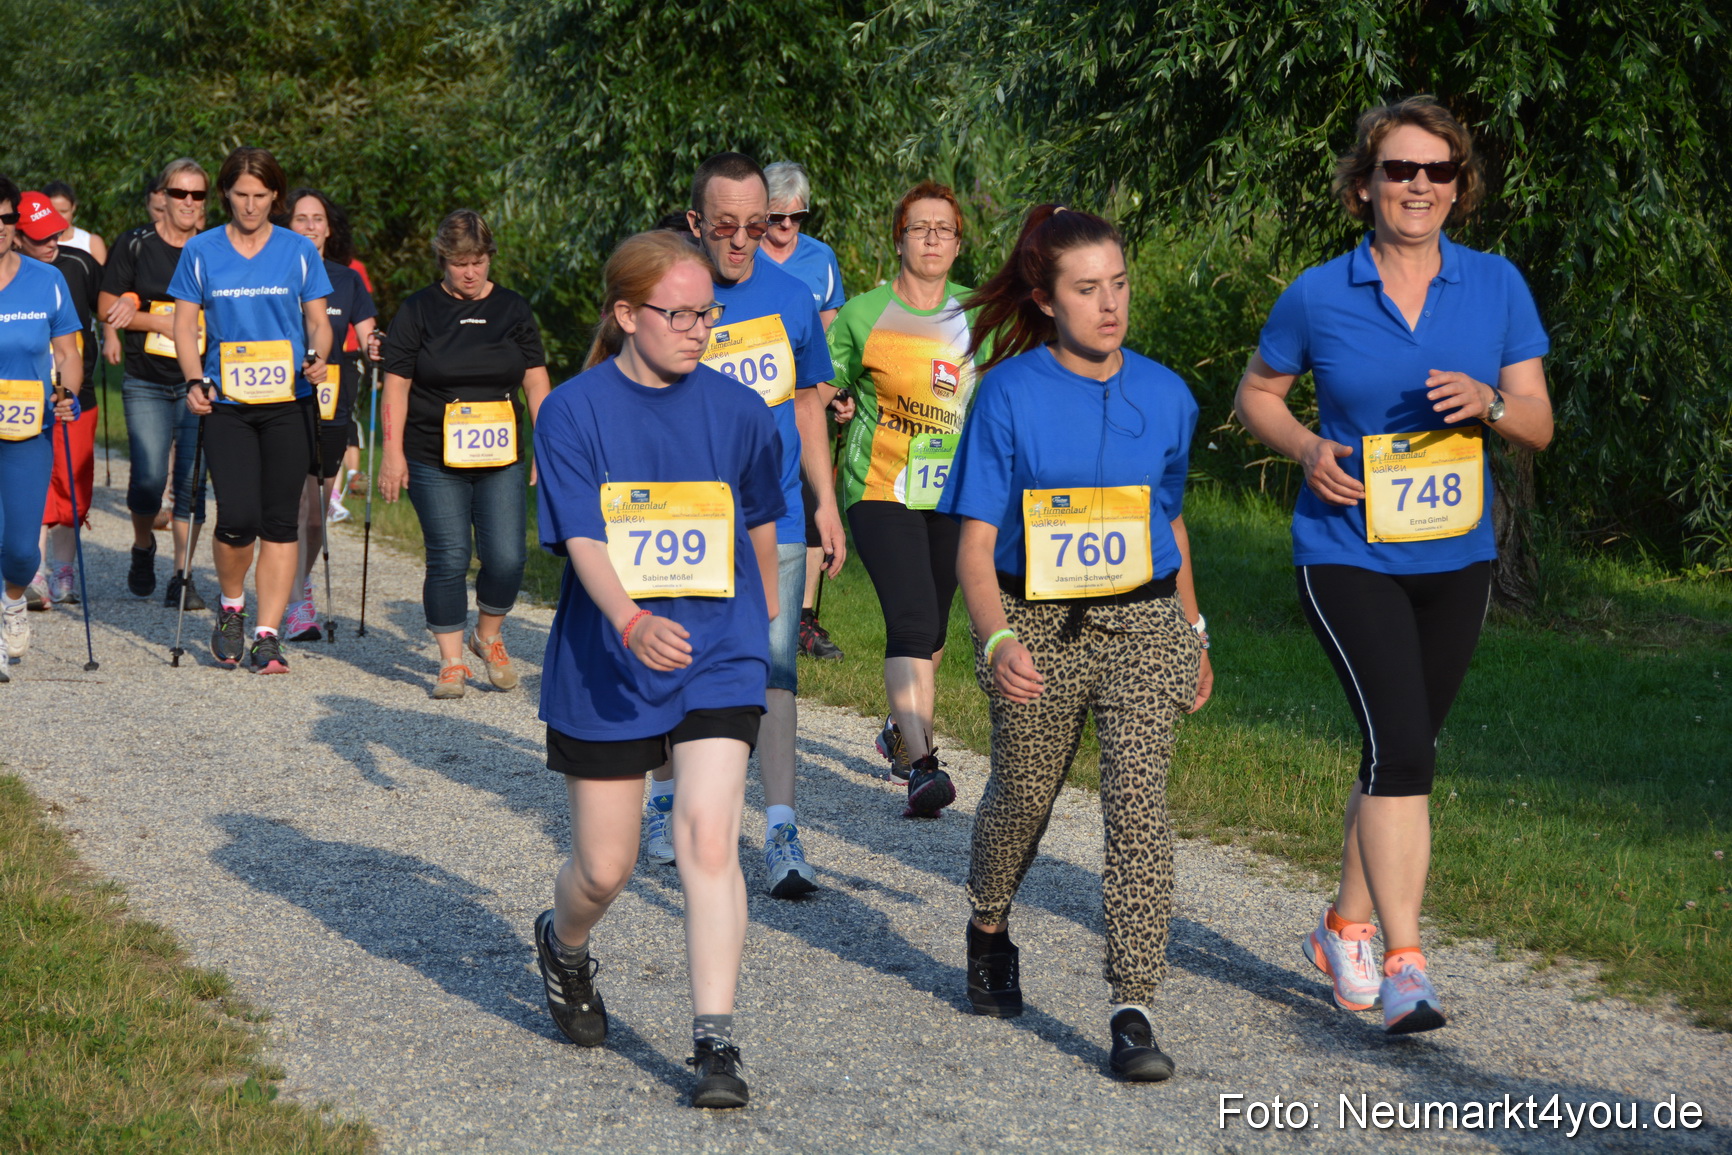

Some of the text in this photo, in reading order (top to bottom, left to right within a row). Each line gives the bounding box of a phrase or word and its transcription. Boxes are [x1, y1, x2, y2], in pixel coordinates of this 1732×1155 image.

[30, 207, 52, 222] DEKRA
[211, 286, 289, 298] energiegeladen
[720, 353, 778, 386] 806
[229, 366, 287, 387] 1329
[453, 427, 509, 449] 1208
[1383, 449, 1427, 461] firmenlauf
[1371, 463, 1407, 474] walken
[1391, 472, 1462, 512] 748
[622, 501, 668, 512] firmenlauf
[1043, 505, 1088, 515] firmenlauf
[609, 514, 646, 524] walken
[1031, 518, 1067, 528] walken
[1409, 515, 1449, 526] Erna Gimbl
[628, 529, 706, 566] 799
[1050, 531, 1126, 567] 760
[642, 573, 694, 582] Sabine Mößel
[1055, 573, 1123, 583] Jasmin Schweiger
